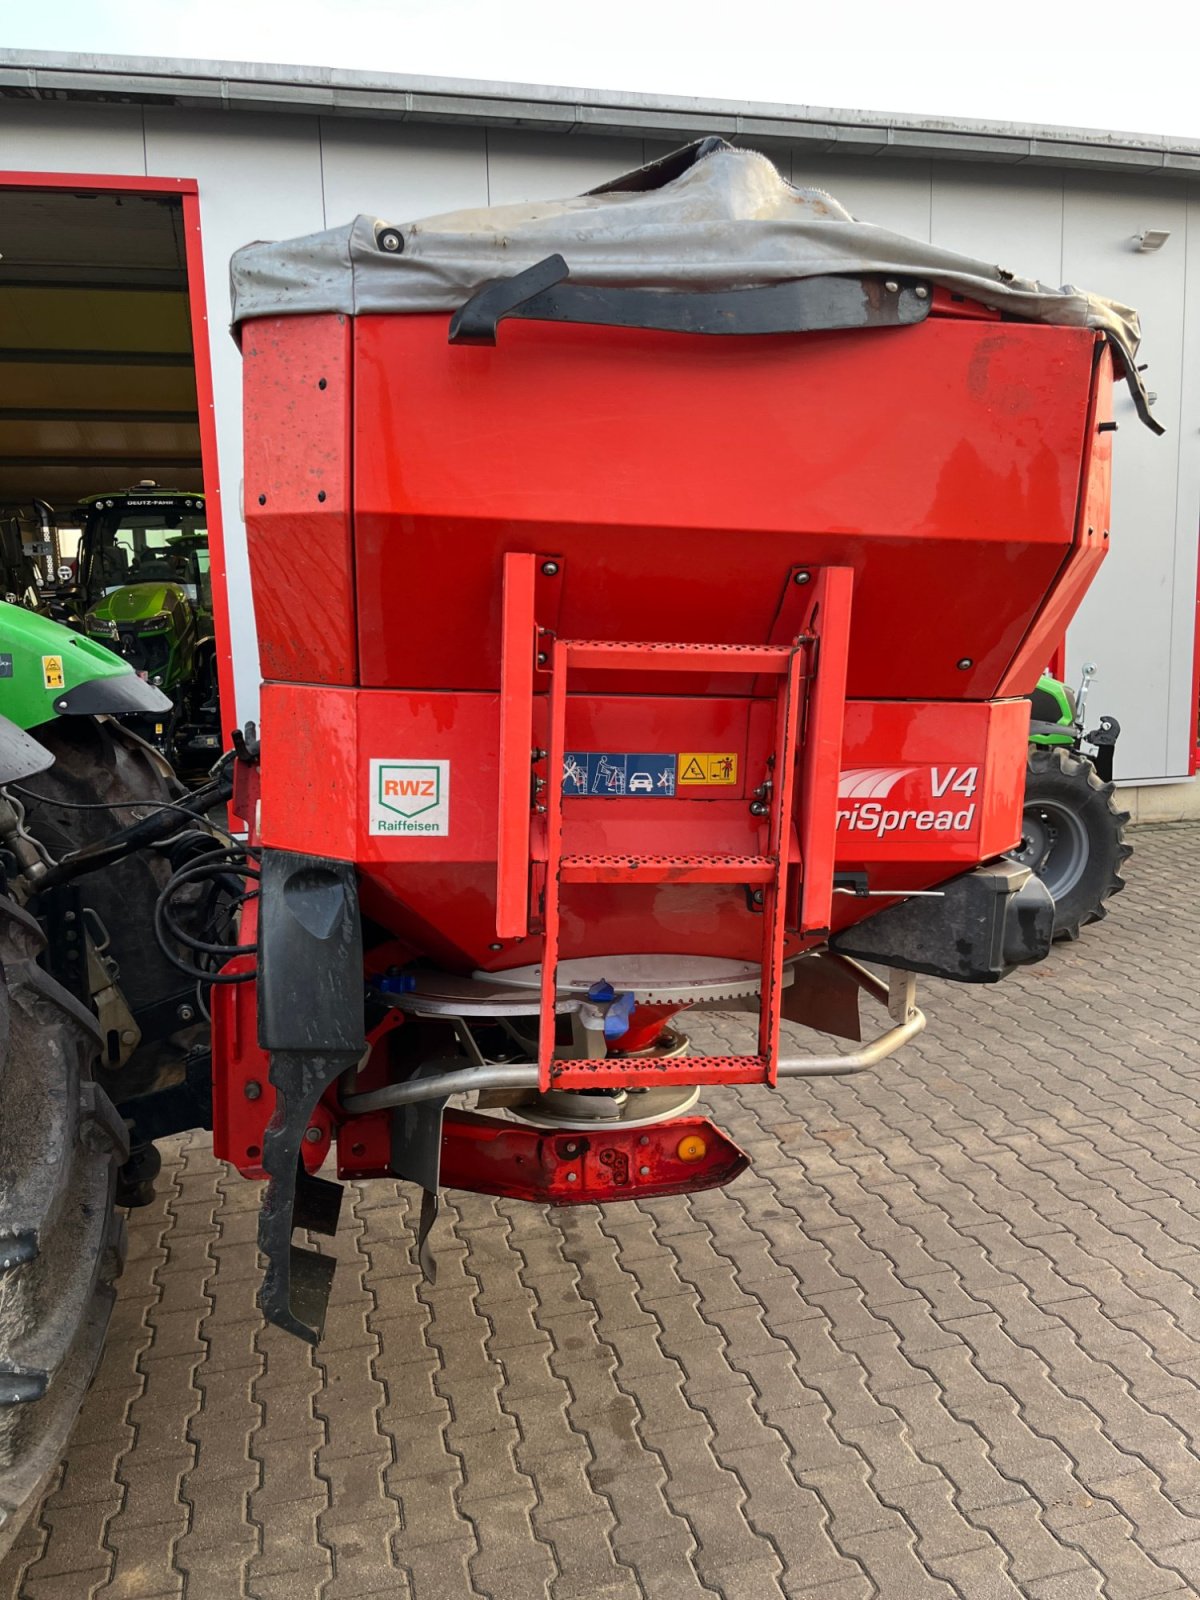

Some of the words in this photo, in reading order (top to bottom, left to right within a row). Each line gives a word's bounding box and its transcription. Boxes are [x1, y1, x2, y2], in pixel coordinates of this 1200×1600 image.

[384, 780, 434, 796] RWZ
[930, 767, 978, 797] V4
[378, 820, 440, 831] Raiffeisen
